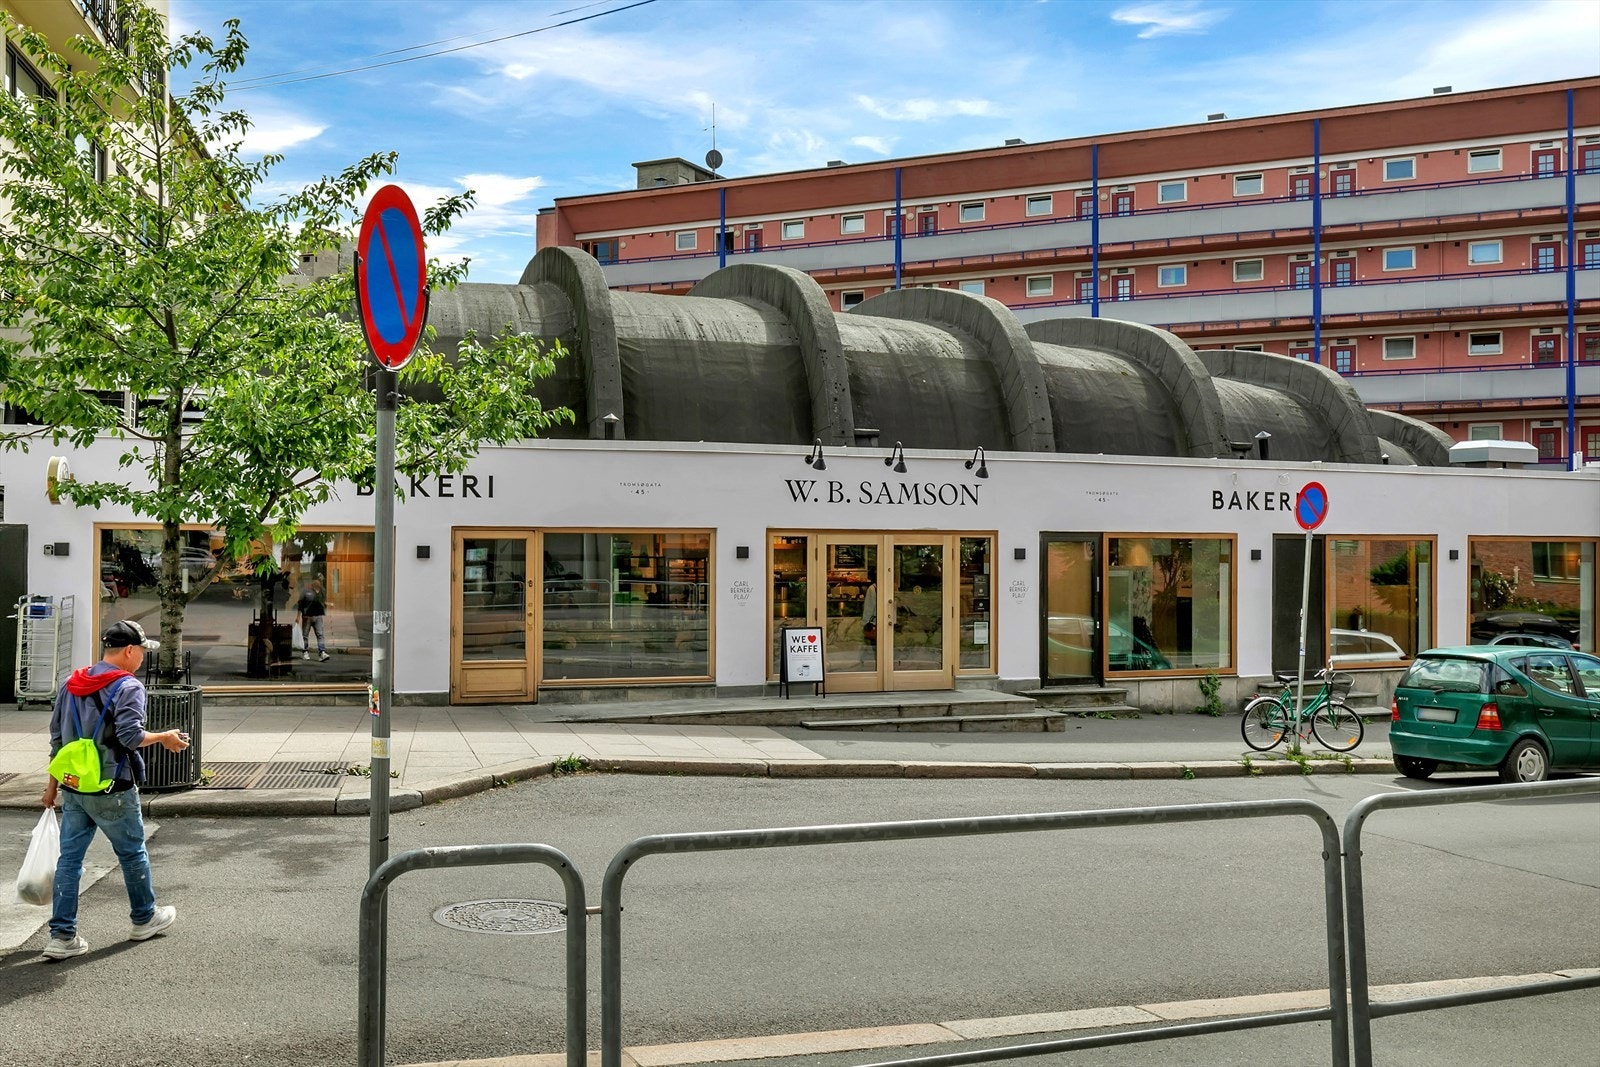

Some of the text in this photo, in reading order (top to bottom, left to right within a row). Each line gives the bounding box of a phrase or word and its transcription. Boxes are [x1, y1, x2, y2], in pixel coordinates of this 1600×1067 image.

[356, 474, 494, 498] BKERI
[785, 479, 982, 506] W. B. SAMSON
[1212, 490, 1299, 511] BAKER
[790, 645, 818, 653] KAFFE
[791, 635, 806, 643] WE
